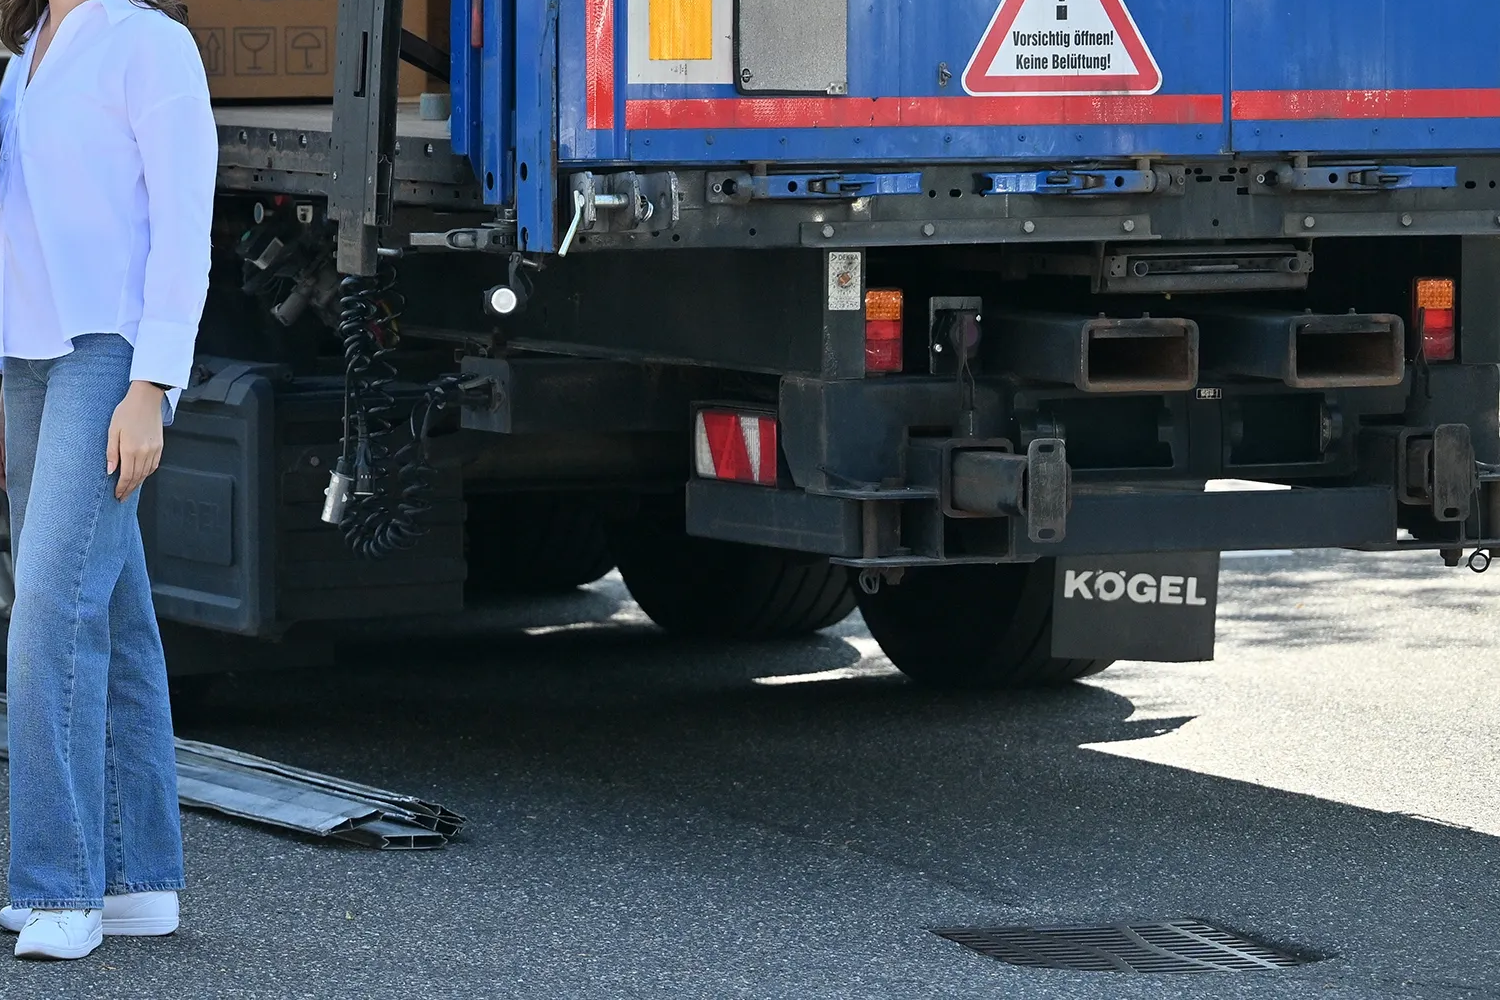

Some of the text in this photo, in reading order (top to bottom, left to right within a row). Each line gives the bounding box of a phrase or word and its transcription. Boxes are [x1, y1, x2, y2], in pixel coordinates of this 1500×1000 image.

[1012, 30, 1114, 48] Vorsichtig öffnen!
[1016, 53, 1111, 71] Keine Belüftung!
[1063, 570, 1207, 606] KÖGEL
